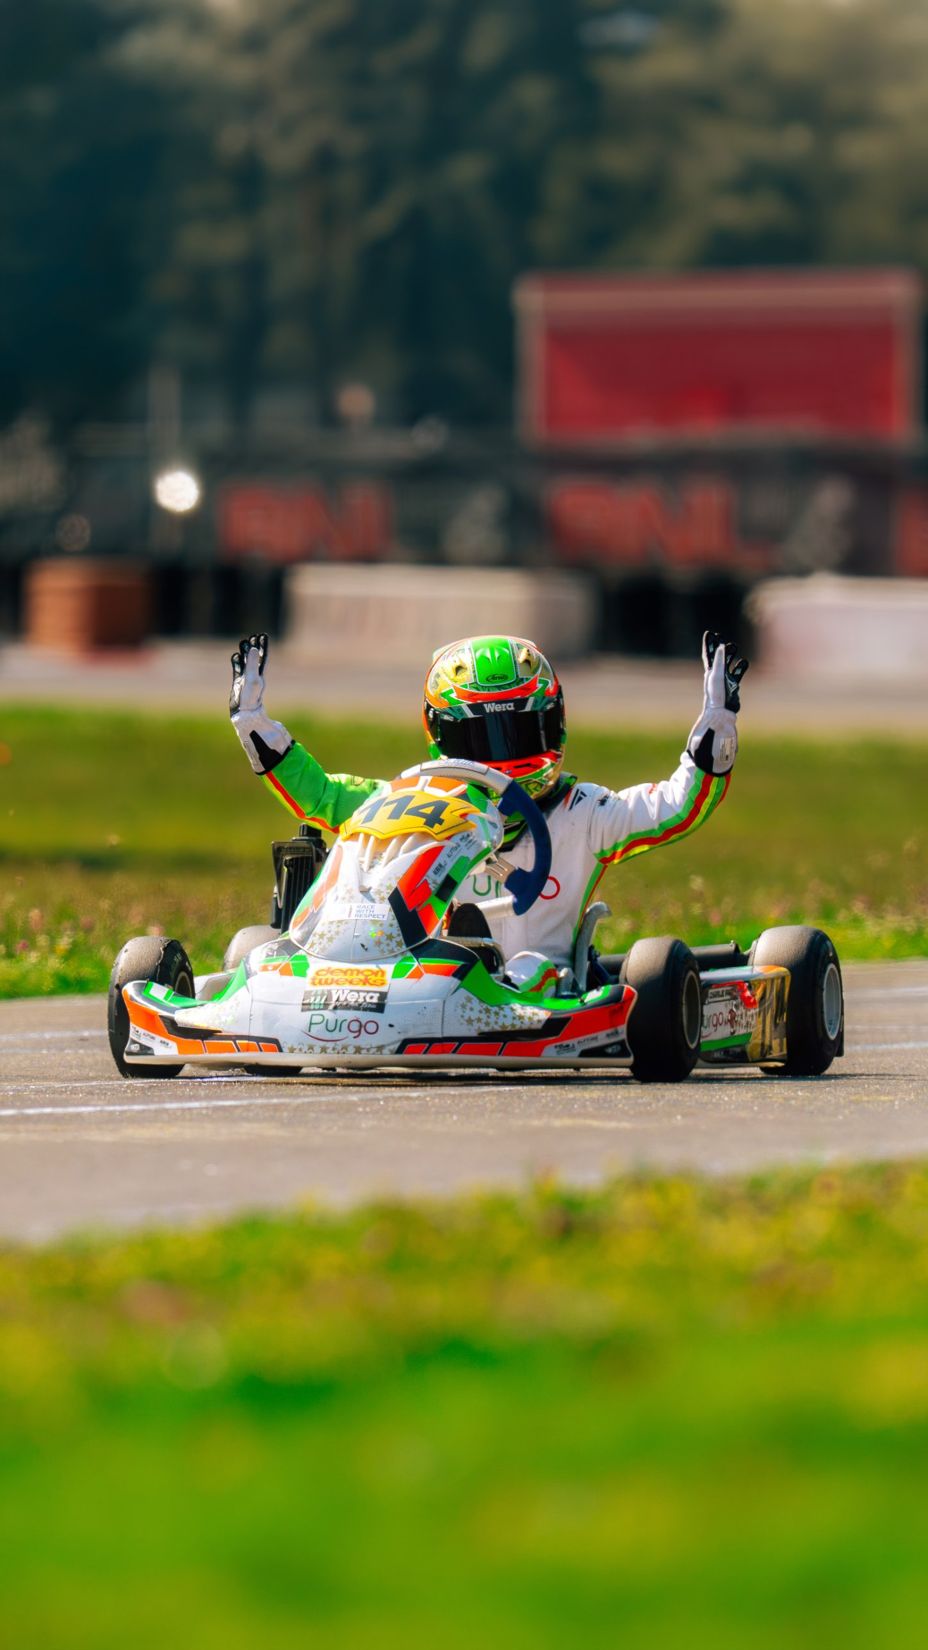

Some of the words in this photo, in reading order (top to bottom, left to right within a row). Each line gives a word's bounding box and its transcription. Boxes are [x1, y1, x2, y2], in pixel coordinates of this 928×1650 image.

[483, 702, 515, 713] Wera
[357, 795, 450, 829] 114
[315, 967, 386, 977] demon
[311, 976, 387, 987] tweeks
[331, 989, 380, 1003] Wera
[308, 1013, 379, 1038] Purgo
